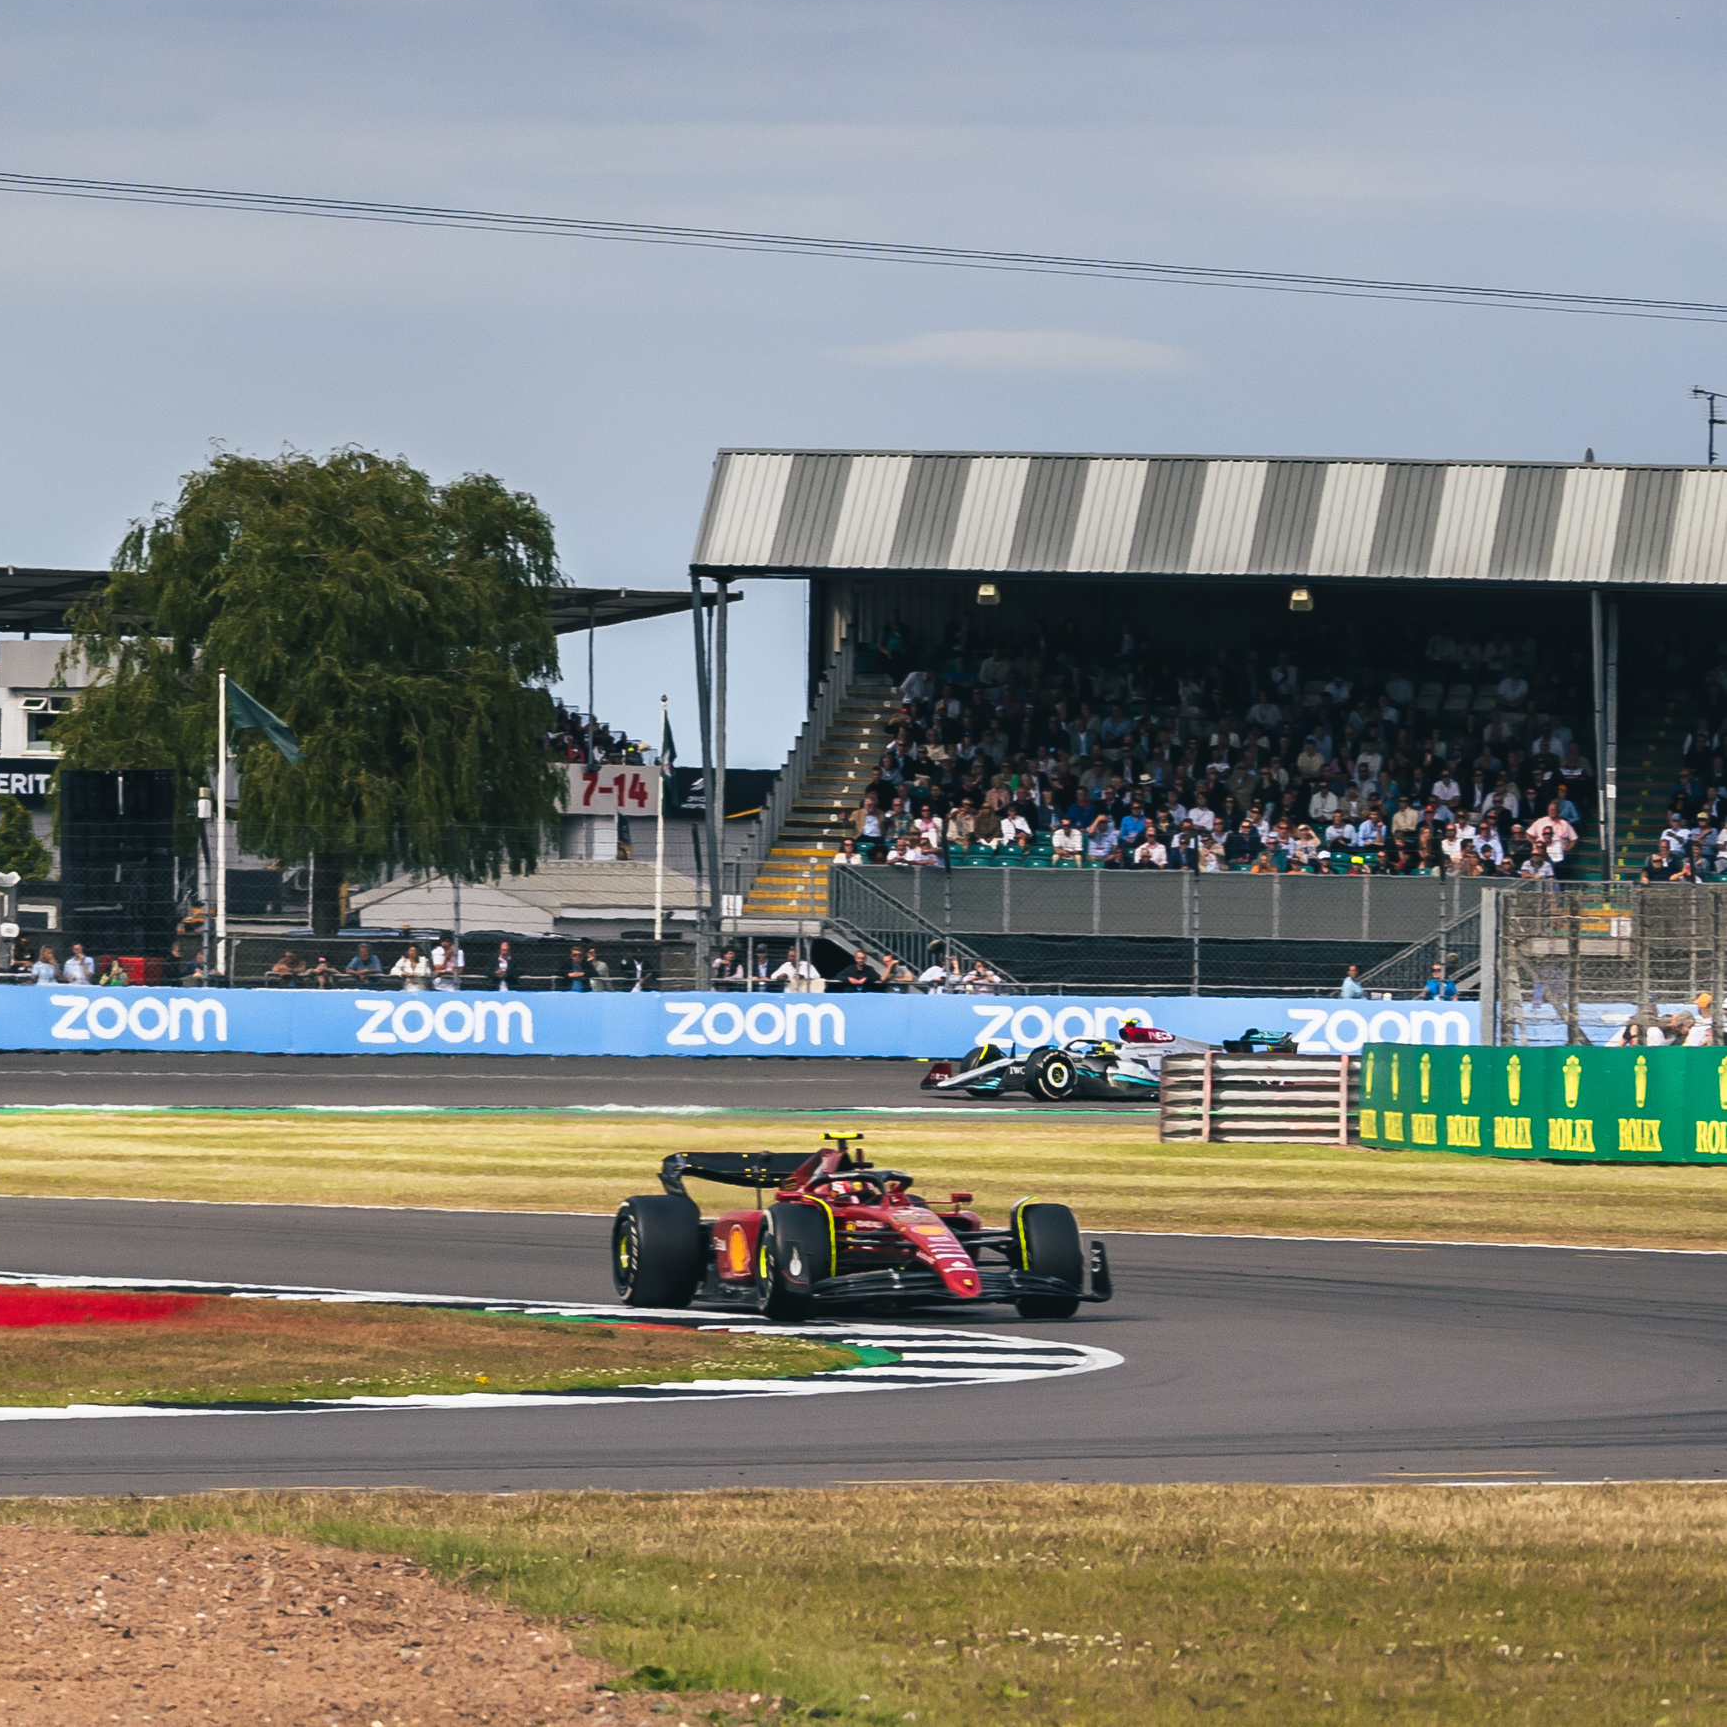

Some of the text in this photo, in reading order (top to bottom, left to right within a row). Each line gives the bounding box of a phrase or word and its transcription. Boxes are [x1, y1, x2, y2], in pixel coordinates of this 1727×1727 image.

[582, 772, 648, 808] 7-14
[50, 995, 226, 1041] zoom
[355, 1000, 532, 1043] zoom
[665, 1002, 845, 1045] zoom
[1148, 1030, 1174, 1041] INEOS
[1288, 1009, 1470, 1052] zoom
[1548, 1118, 1596, 1152] ROLEX
[1618, 1118, 1662, 1151] ROLEX
[1695, 1120, 1727, 1154] ROL
